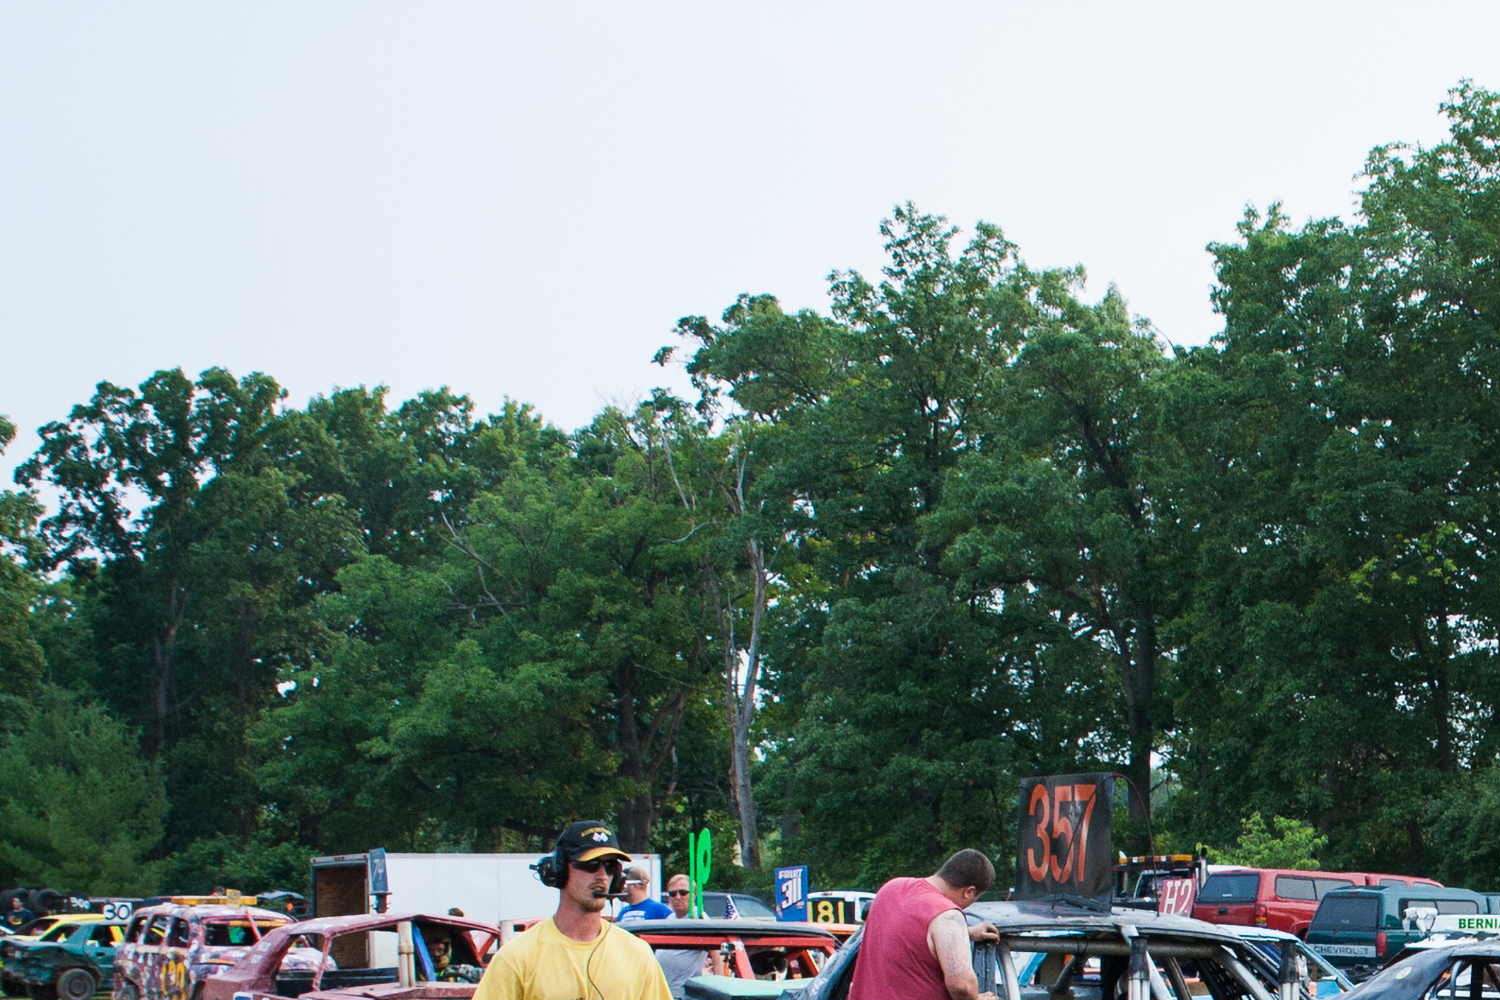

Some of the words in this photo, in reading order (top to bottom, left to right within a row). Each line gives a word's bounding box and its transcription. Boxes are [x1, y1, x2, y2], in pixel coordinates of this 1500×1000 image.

[1027, 783, 1096, 883] 357
[103, 903, 131, 920] 30
[1163, 879, 1193, 915] H2
